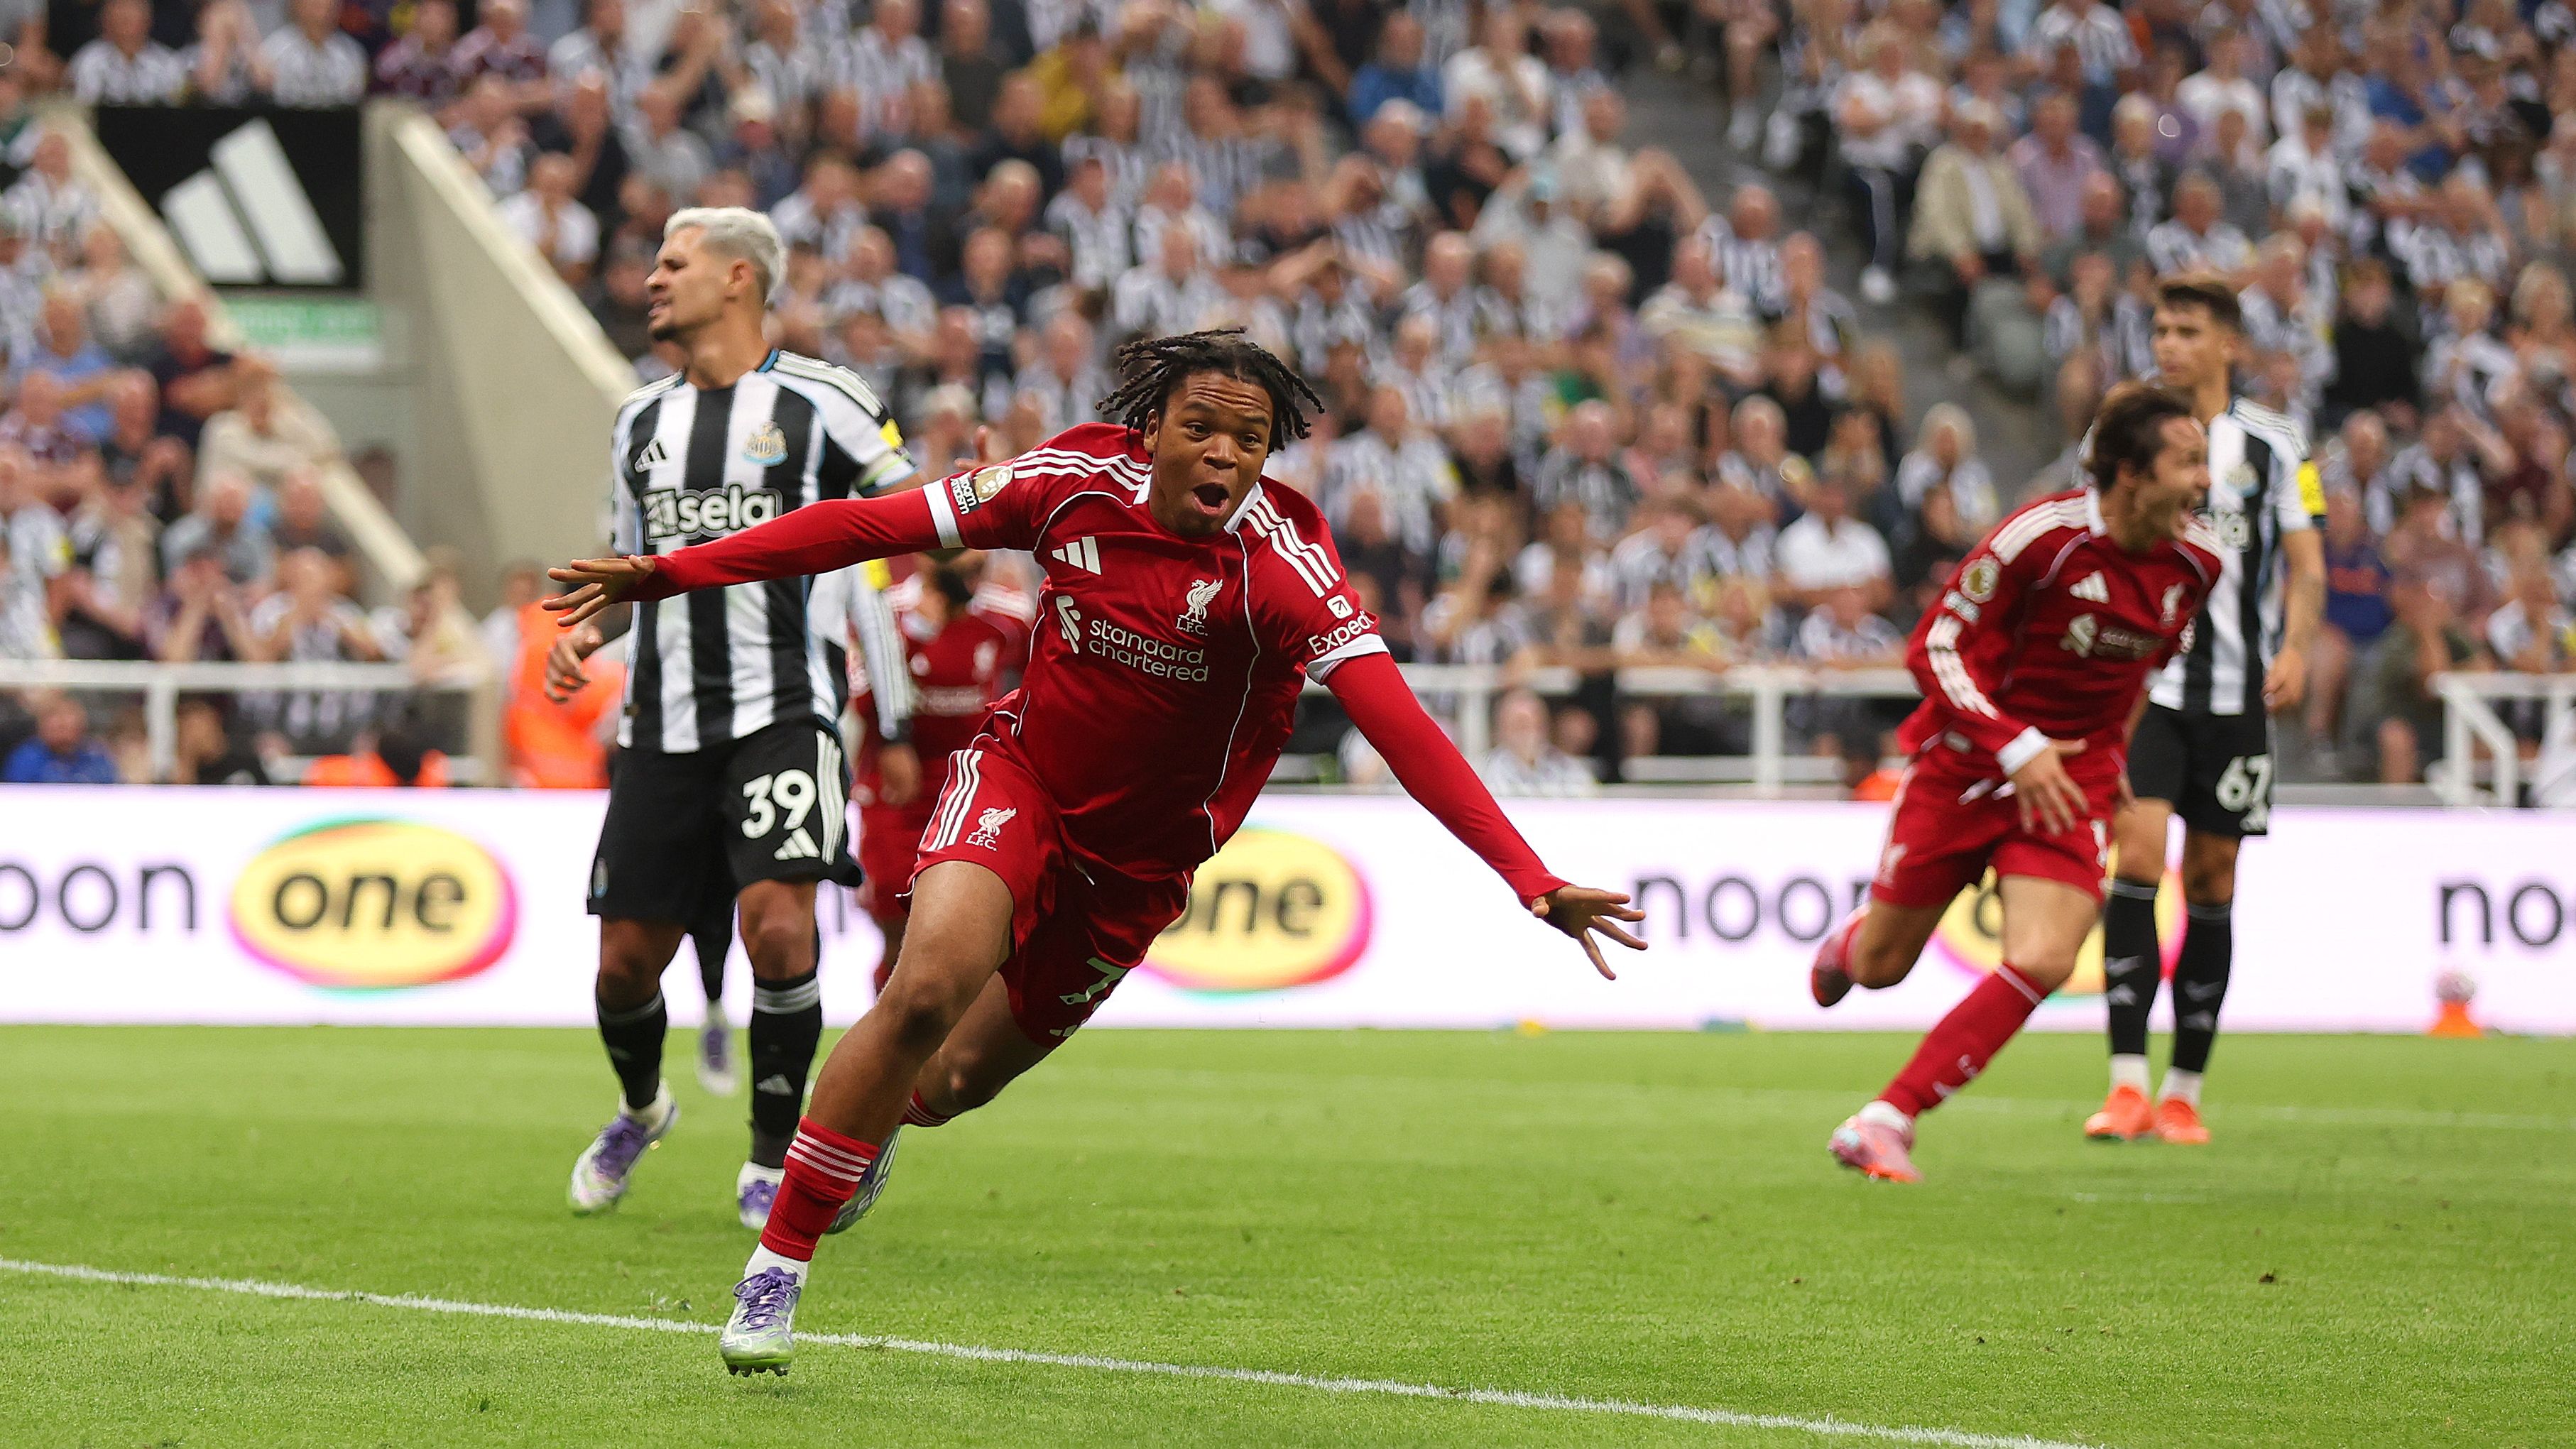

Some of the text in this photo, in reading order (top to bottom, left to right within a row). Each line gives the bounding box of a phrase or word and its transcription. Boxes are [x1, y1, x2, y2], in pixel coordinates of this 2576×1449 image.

[677, 485, 776, 533] sela
[1088, 640, 1209, 682] chartered
[1089, 620, 1204, 665] standard
[741, 769, 817, 839] 39
[2215, 754, 2271, 811] 67
[274, 873, 465, 931] one
[1059, 957, 1128, 1005] 7
